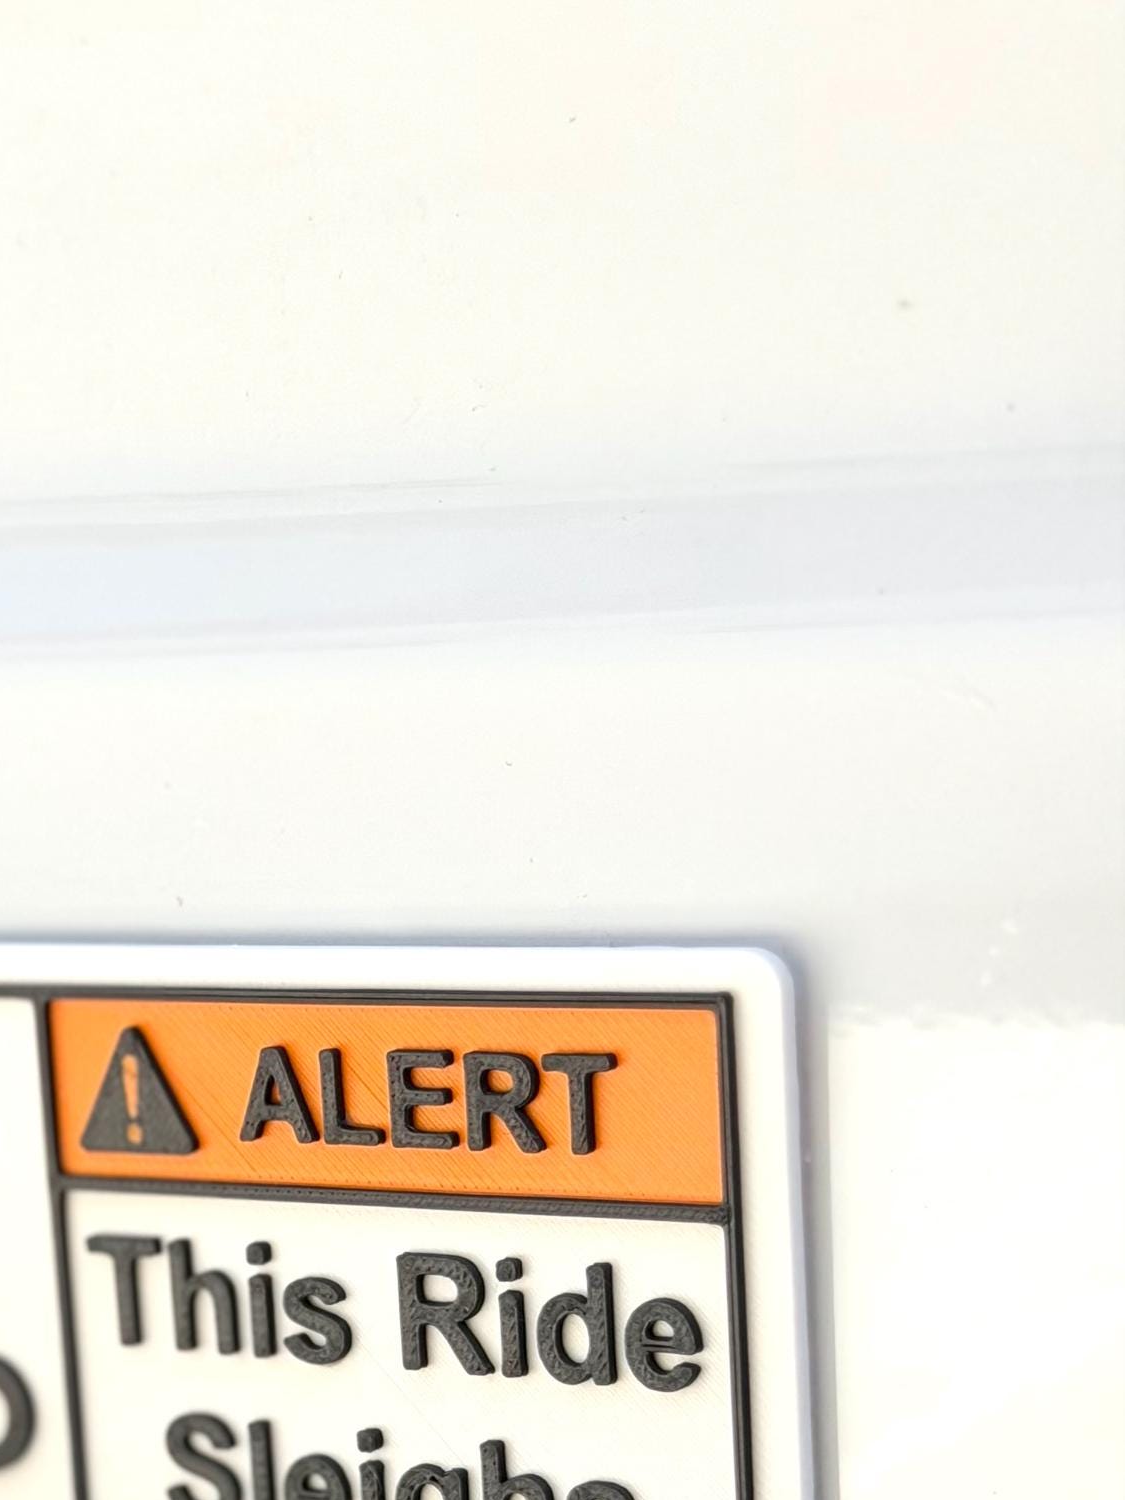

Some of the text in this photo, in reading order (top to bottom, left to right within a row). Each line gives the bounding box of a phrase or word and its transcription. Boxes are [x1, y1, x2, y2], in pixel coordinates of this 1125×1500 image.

[239, 1045, 618, 1155] ALERT
[86, 1234, 704, 1392] This Ride
